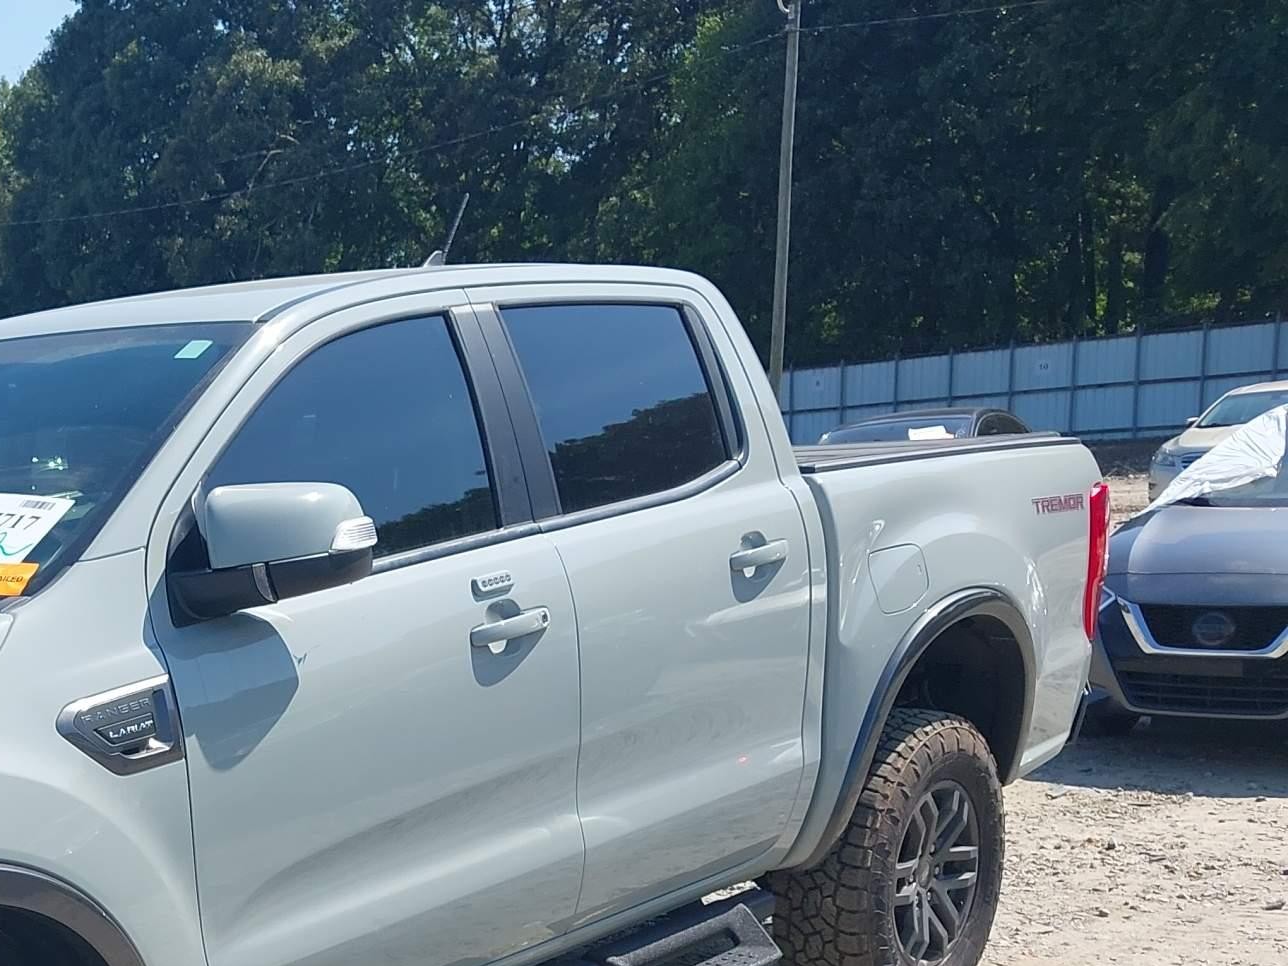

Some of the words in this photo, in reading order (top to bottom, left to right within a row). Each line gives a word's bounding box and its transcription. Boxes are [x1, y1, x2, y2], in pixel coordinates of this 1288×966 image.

[1031, 493, 1084, 514] TREMOR
[80, 697, 151, 724] RANGER
[109, 719, 154, 738] LARIAT
